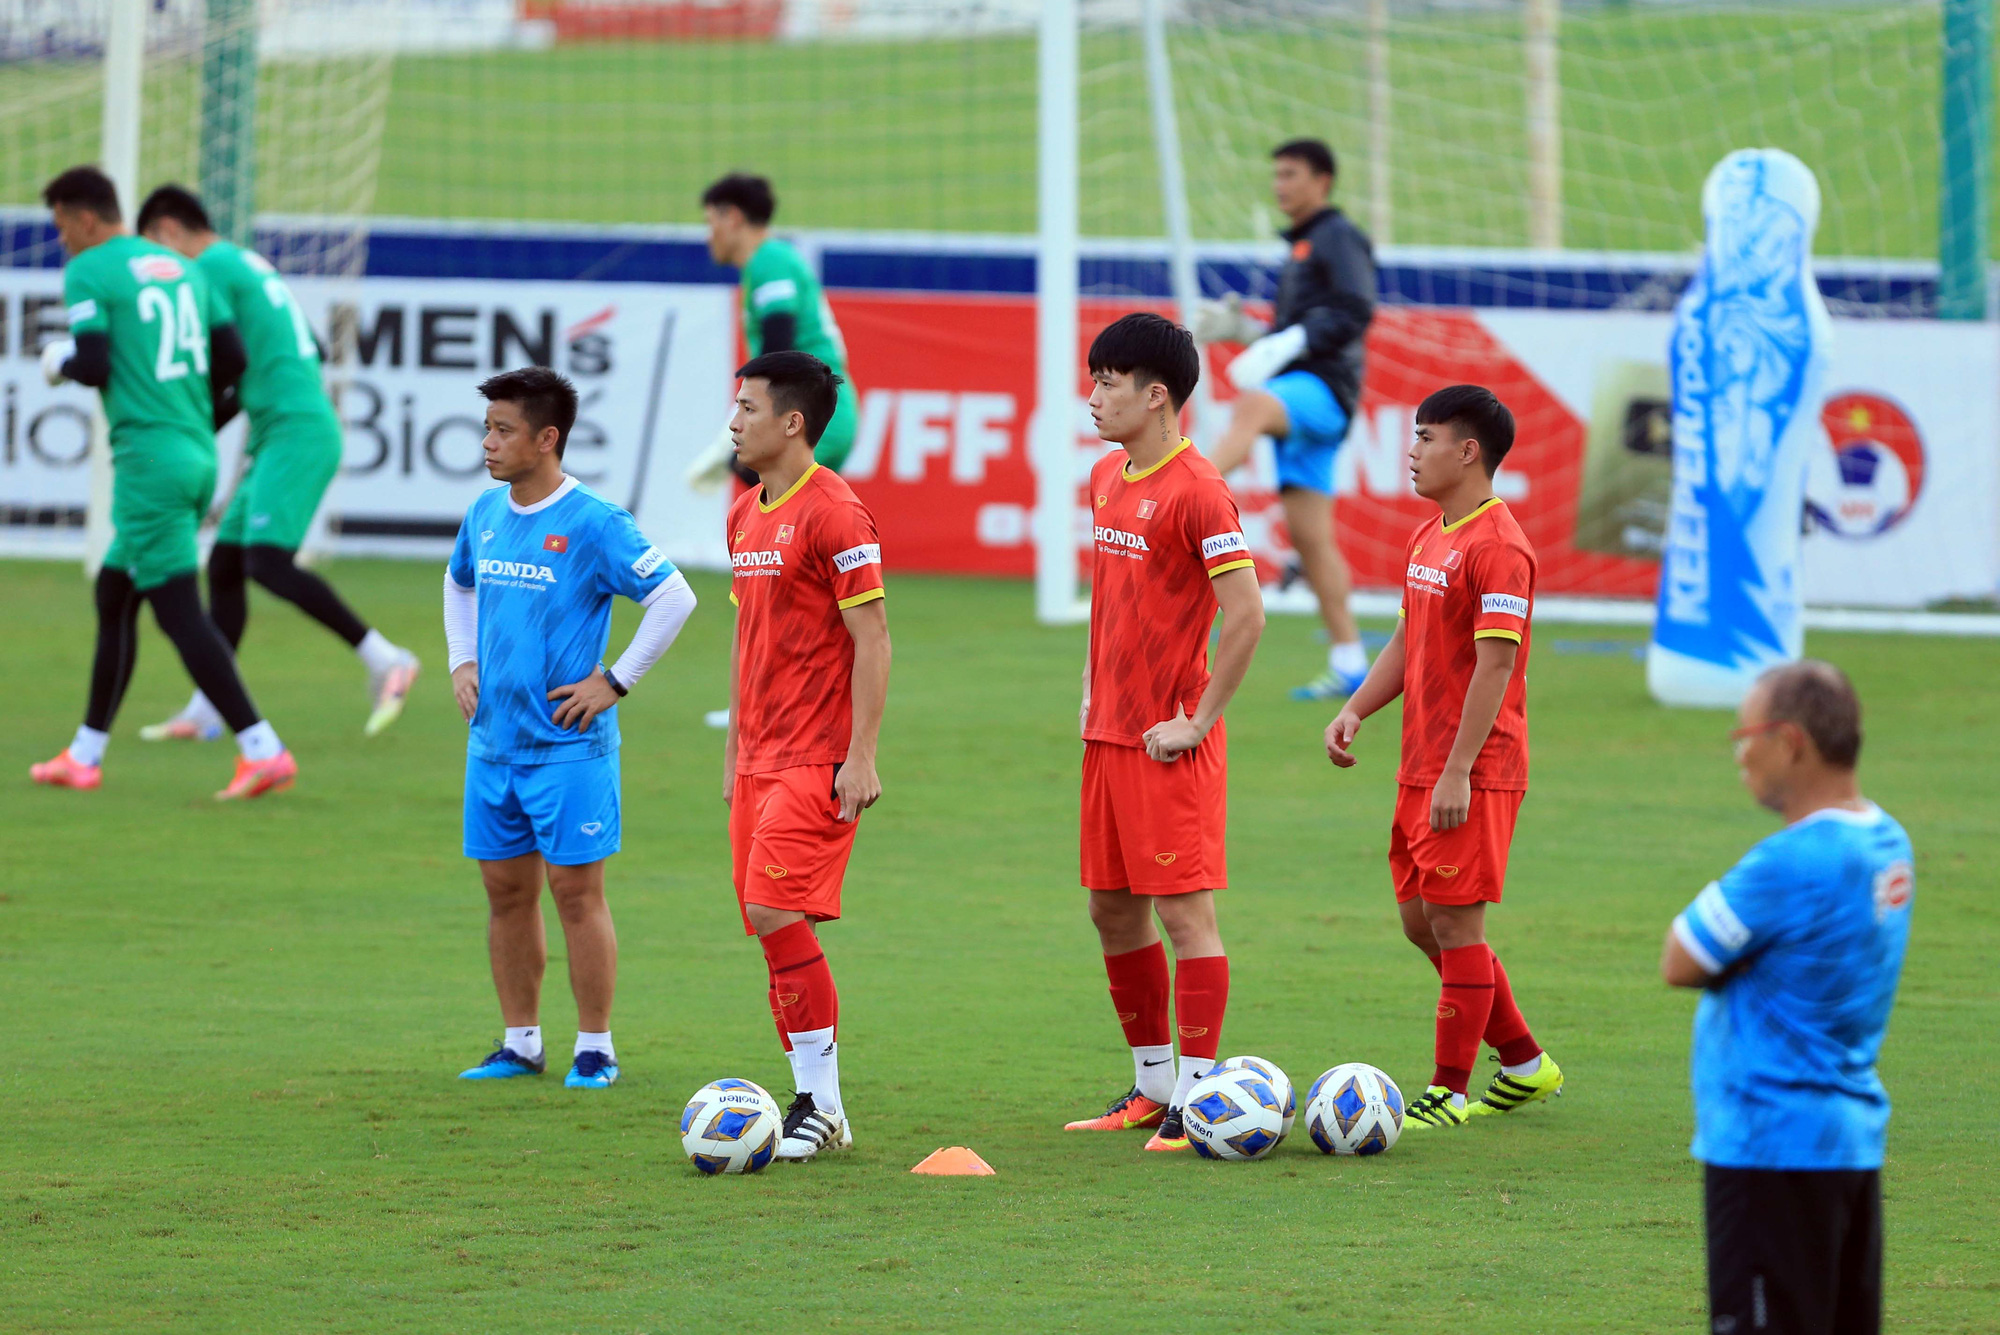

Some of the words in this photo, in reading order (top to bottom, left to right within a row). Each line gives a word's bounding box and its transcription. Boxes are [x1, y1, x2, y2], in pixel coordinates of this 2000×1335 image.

[137, 283, 208, 382] 24
[1095, 525, 1150, 551] HONDA
[478, 559, 557, 583] HONDA
[732, 550, 785, 568] HONDA
[760, 568, 781, 576] Dreams
[1407, 562, 1449, 588] HONDA
[488, 577, 509, 586] Power
[519, 580, 547, 592] Dreams
[719, 1095, 760, 1105] molten
[1184, 1114, 1213, 1139] molten
